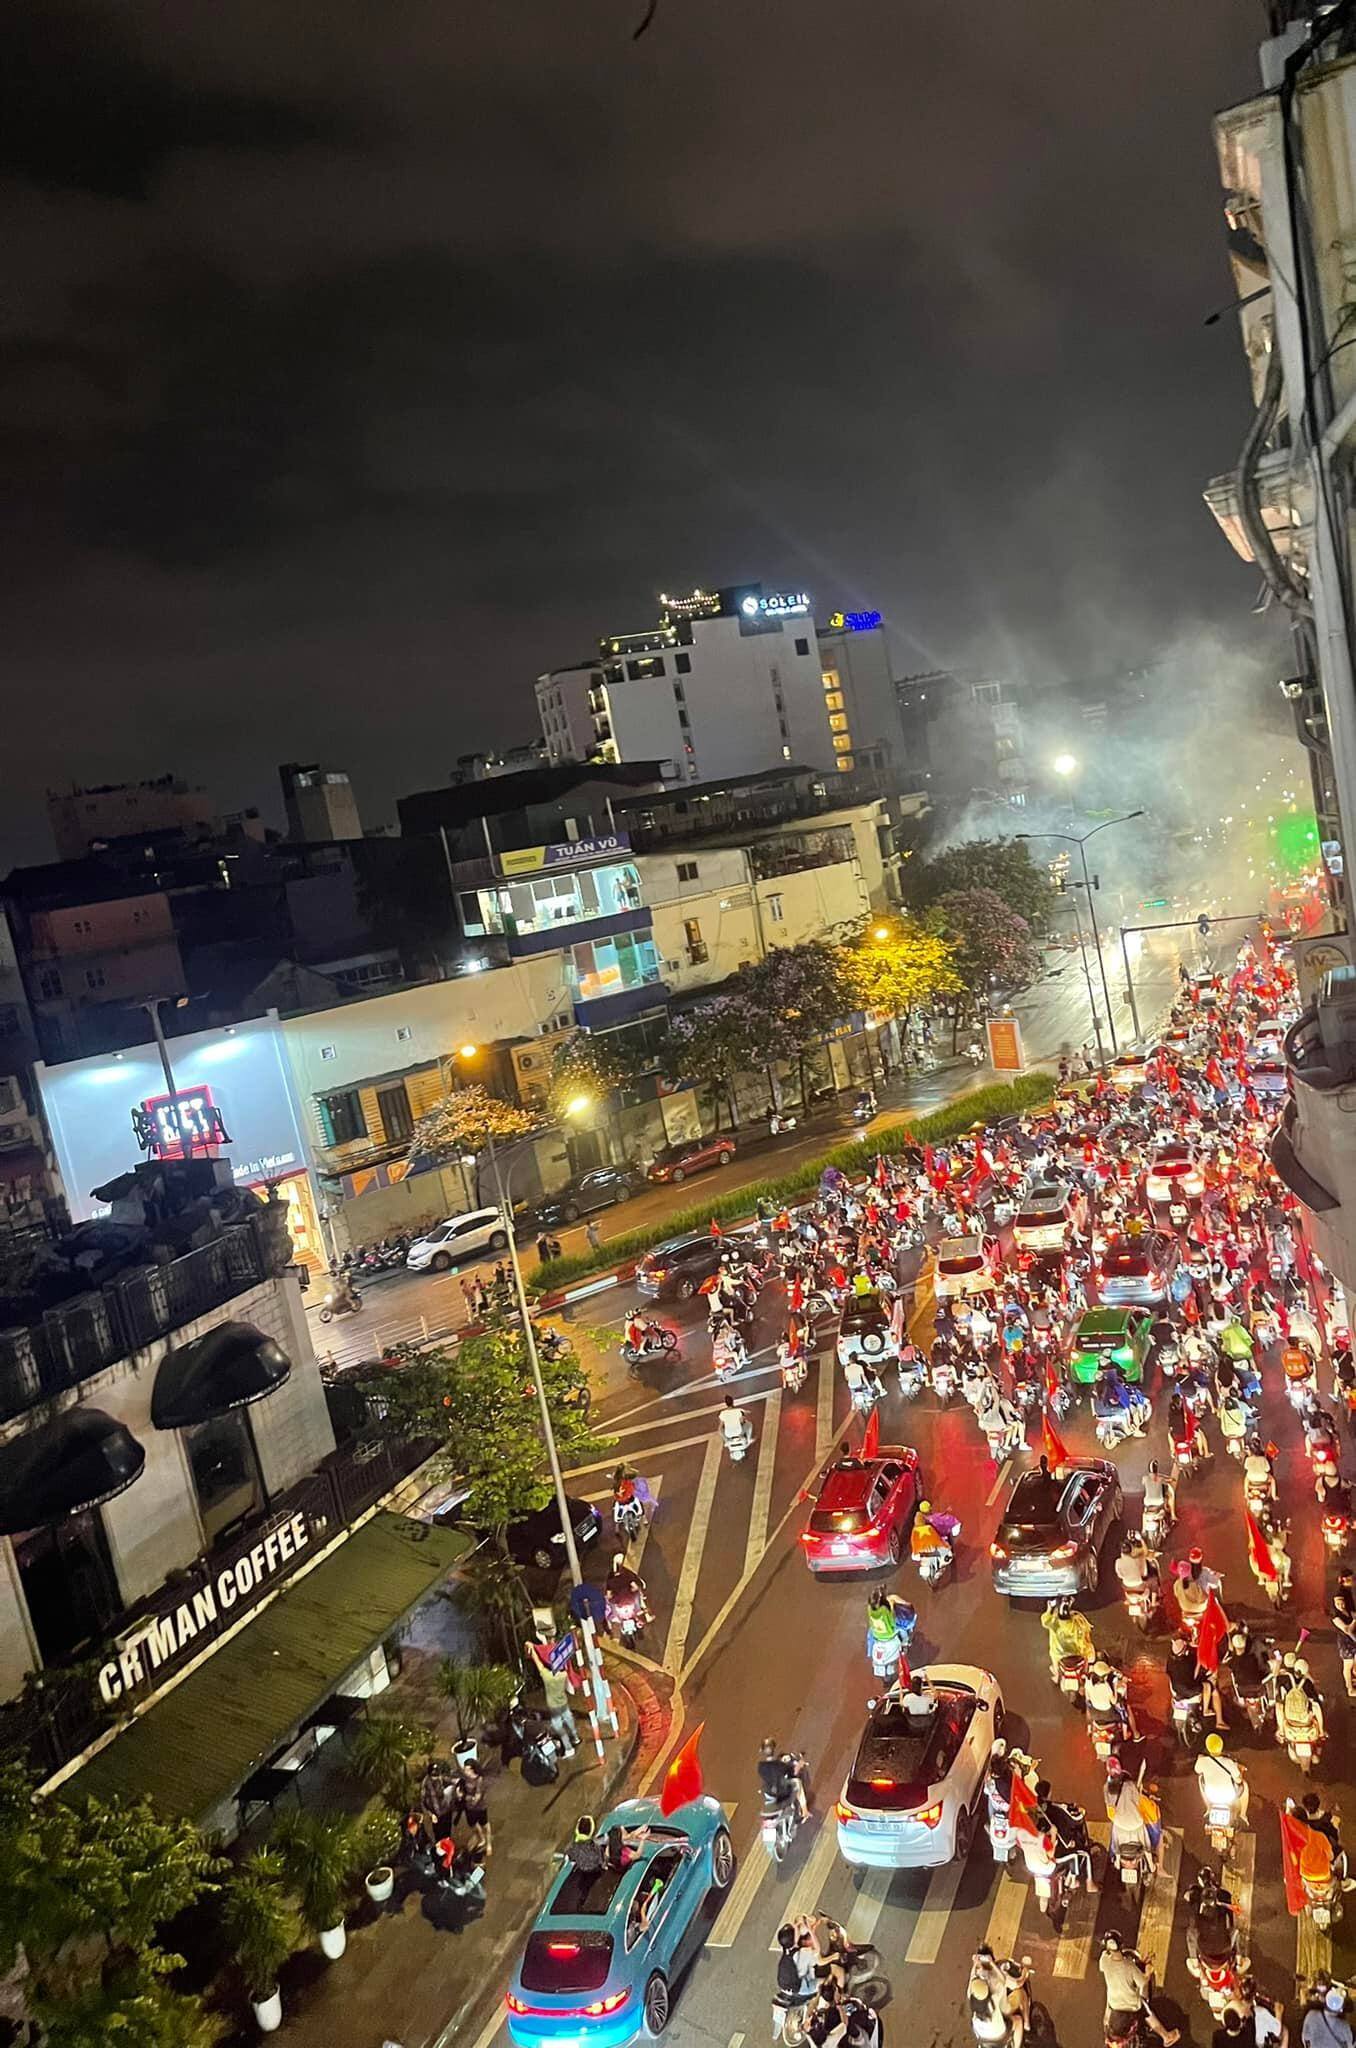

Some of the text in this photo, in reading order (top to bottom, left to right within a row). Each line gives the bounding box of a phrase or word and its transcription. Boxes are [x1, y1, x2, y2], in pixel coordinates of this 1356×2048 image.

[759, 593, 810, 609] SOLEIL
[146, 1585, 218, 1669] MAN
[217, 1511, 309, 1609] COFFEE
